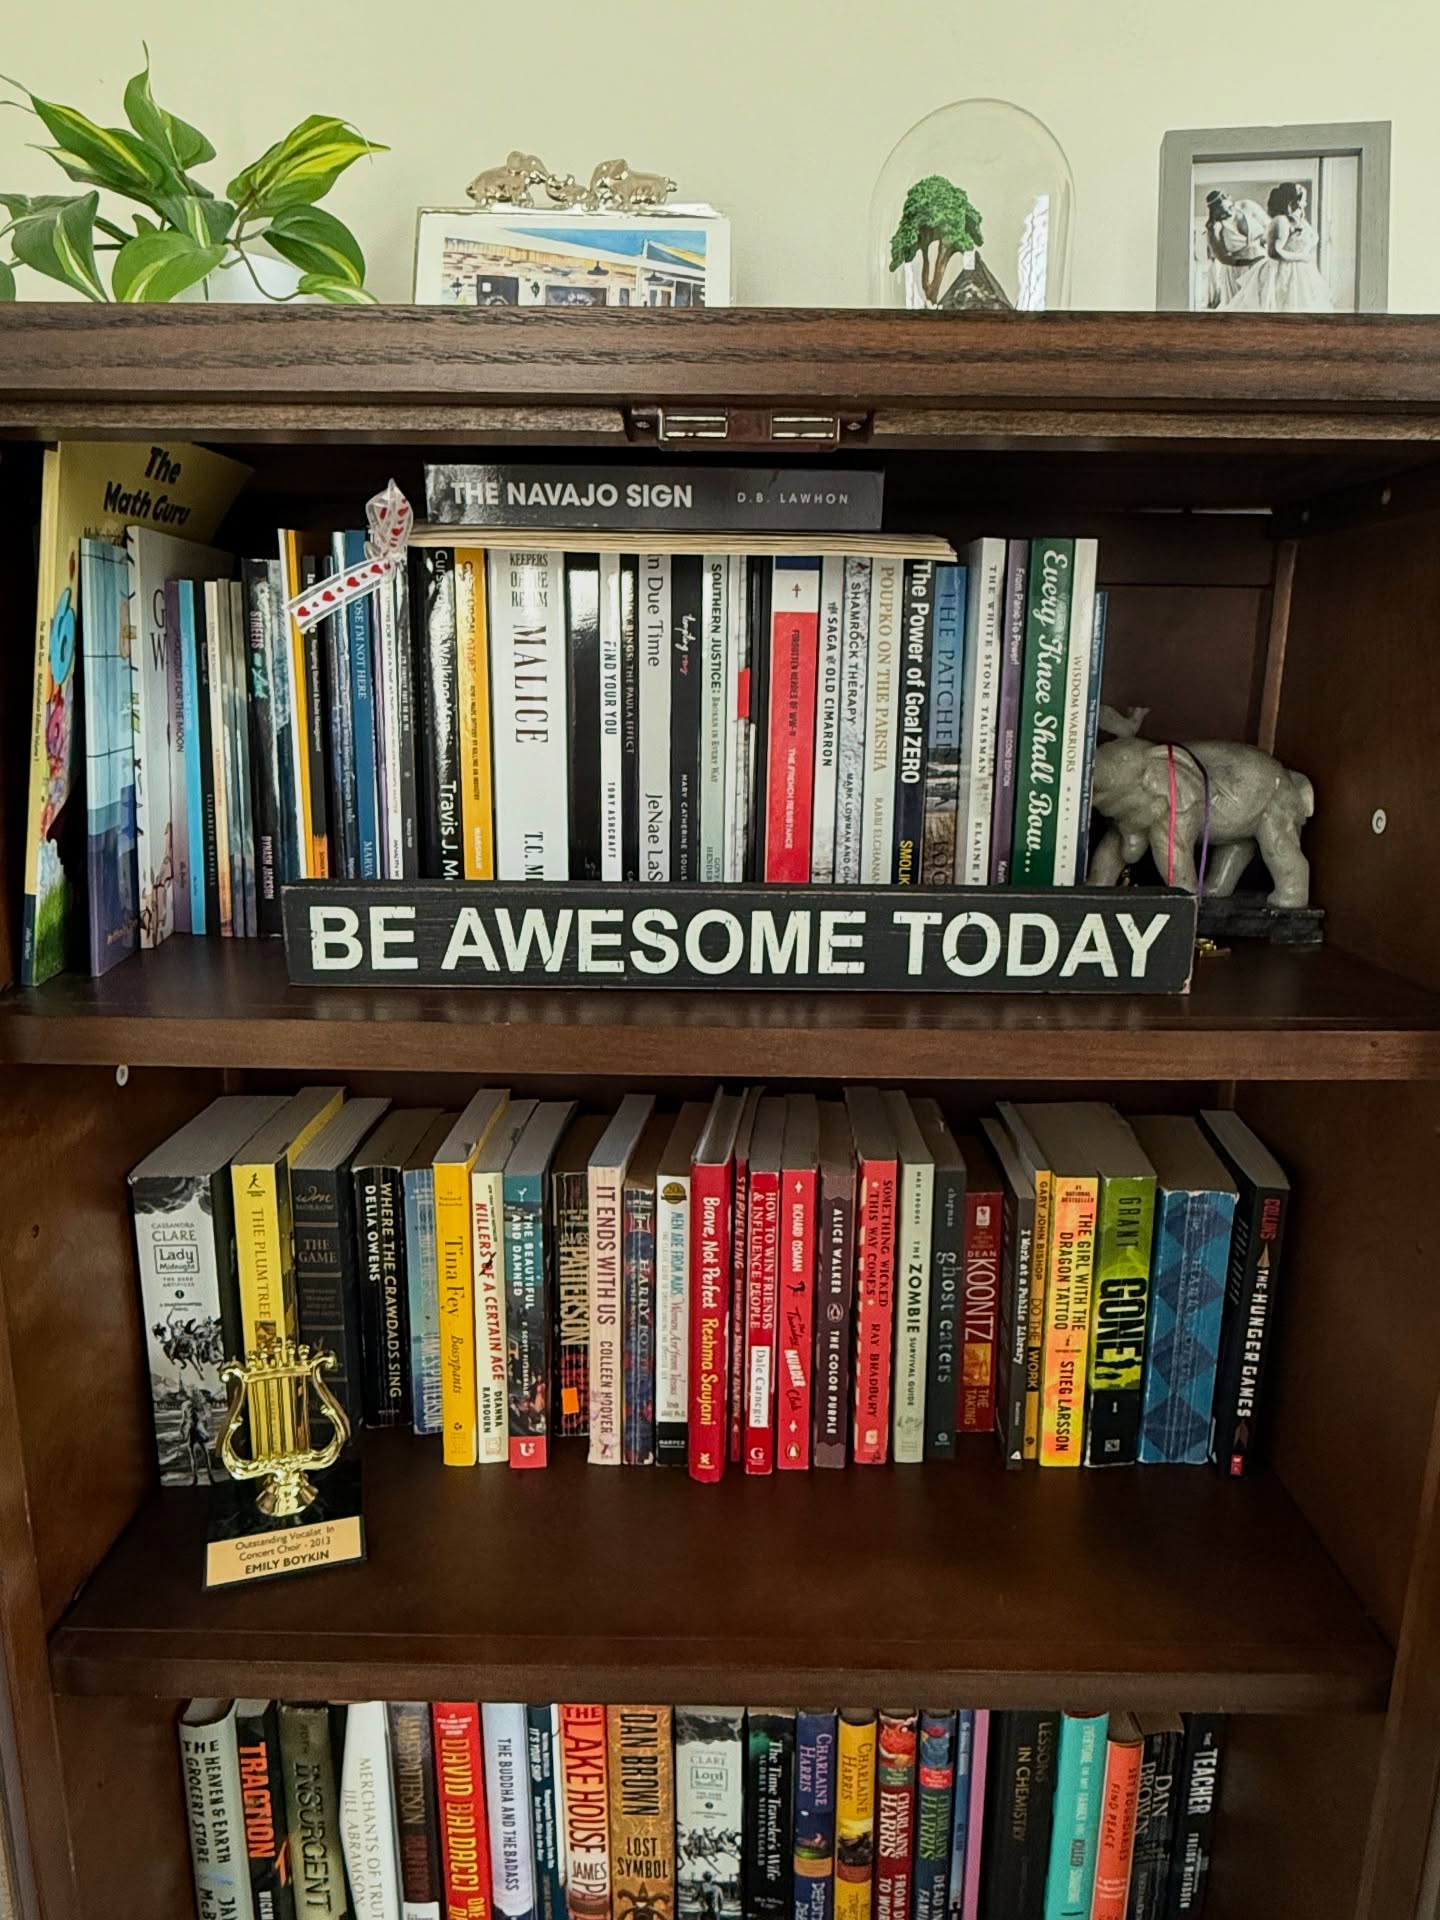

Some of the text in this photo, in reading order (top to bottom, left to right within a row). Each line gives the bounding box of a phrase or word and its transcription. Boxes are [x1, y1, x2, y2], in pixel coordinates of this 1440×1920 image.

[104, 481, 191, 525] Math Guru
[145, 447, 181, 484] The
[451, 482, 692, 508] THE NAVAJO SIGN
[737, 493, 849, 505] D.B. LAWHON
[711, 563, 722, 694] SOUTHERN JUSTICE:
[846, 582, 861, 723] SHAMROCK THERAPY
[1009, 568, 1025, 665] From Panic To Power!
[513, 625, 549, 743] MALICE
[604, 640, 617, 735] FIND YOUR YOU
[873, 567, 895, 772] POUPKO ON THE PARSHA
[902, 561, 931, 784] The Power of Goal ZERO
[978, 566, 996, 774] THE WHITE STONE TALISMAN
[1025, 550, 1068, 873] Every Knee Shall Bow...
[1066, 656, 1083, 772] WISDOM WARRIORS
[608, 810, 616, 858] ASHCRAFT
[680, 802, 689, 849] CATHERINE
[680, 854, 689, 880] SOULS
[899, 840, 913, 884] SMOLIK
[310, 906, 1170, 977] BE AWESOME TODAY
[252, 1209, 271, 1317] THE PLUM TREE
[365, 1185, 380, 1281] DELIA OWENS
[441, 1236, 466, 1317] Tina Fey
[512, 1215, 522, 1296] AND DAMNED
[524, 1215, 535, 1309] THE BEAUTIFUL
[597, 1186, 616, 1325] IT ENDS WITH US
[702, 1197, 721, 1308] Brave, Not Perfect
[750, 1192, 763, 1328] & INFLUENCE PEOPLE
[762, 1192, 776, 1329] HOW TO WIN FRIENDS
[831, 1209, 843, 1293] ALICE WALKER
[866, 1192, 880, 1295] THIS WAY COMES
[879, 1180, 893, 1307] SOMETHING WICKED
[1072, 1213, 1092, 1330] THE GIRL WITH THE
[1095, 1197, 1147, 1358] GRANT GONE
[381, 1183, 402, 1398] WHERE THE CRAWDADS SING
[907, 1264, 922, 1333] ZOMBIE
[938, 1252, 961, 1383] ghost eaters
[965, 1258, 996, 1340] KOONTZ
[1056, 1232, 1072, 1330] DRAGON TATTOO
[449, 1336, 463, 1394] Bossypants
[601, 1341, 614, 1433] COLLEEN HOOVER
[697, 1318, 718, 1425] Reshma Saujani
[826, 1331, 840, 1433] THE COLOR PURPLE
[867, 1323, 881, 1417] RAY BRADBURY
[908, 1337, 917, 1377] SURVIVAL
[1237, 1270, 1268, 1417] THE HUNGER GAMES
[1056, 1361, 1074, 1451] STIEG LARSSON
[235, 1535, 287, 1551] Outstanding
[289, 1528, 322, 1541] Vocalist
[239, 1549, 275, 1561] Concert
[276, 1543, 302, 1555] Choir
[311, 1537, 331, 1549] 2013
[245, 1550, 330, 1575] EMILY BOYKIN
[205, 1757, 223, 1804] HEAVEN
[240, 1741, 275, 1857] TRACTION
[564, 1720, 605, 1852] LAKE HOUSE
[620, 1714, 659, 1815] DAN BROWN
[768, 1765, 782, 1794] Time
[769, 1740, 783, 1763] The
[800, 1745, 815, 1792] HARRIS
[815, 1734, 832, 1806] CHARLAINE
[1188, 1748, 1218, 1815] TEACHER
[186, 1758, 209, 1863] GROCERY STORE
[213, 1821, 230, 1863] EARTH
[294, 1762, 331, 1911] INSURGENT
[441, 1738, 478, 1891] DAVID BALDACCI
[498, 1739, 519, 1890] THE BUDDHA AND THE BADASS
[767, 1798, 781, 1850] Traveler's
[767, 1854, 780, 1881] Wife
